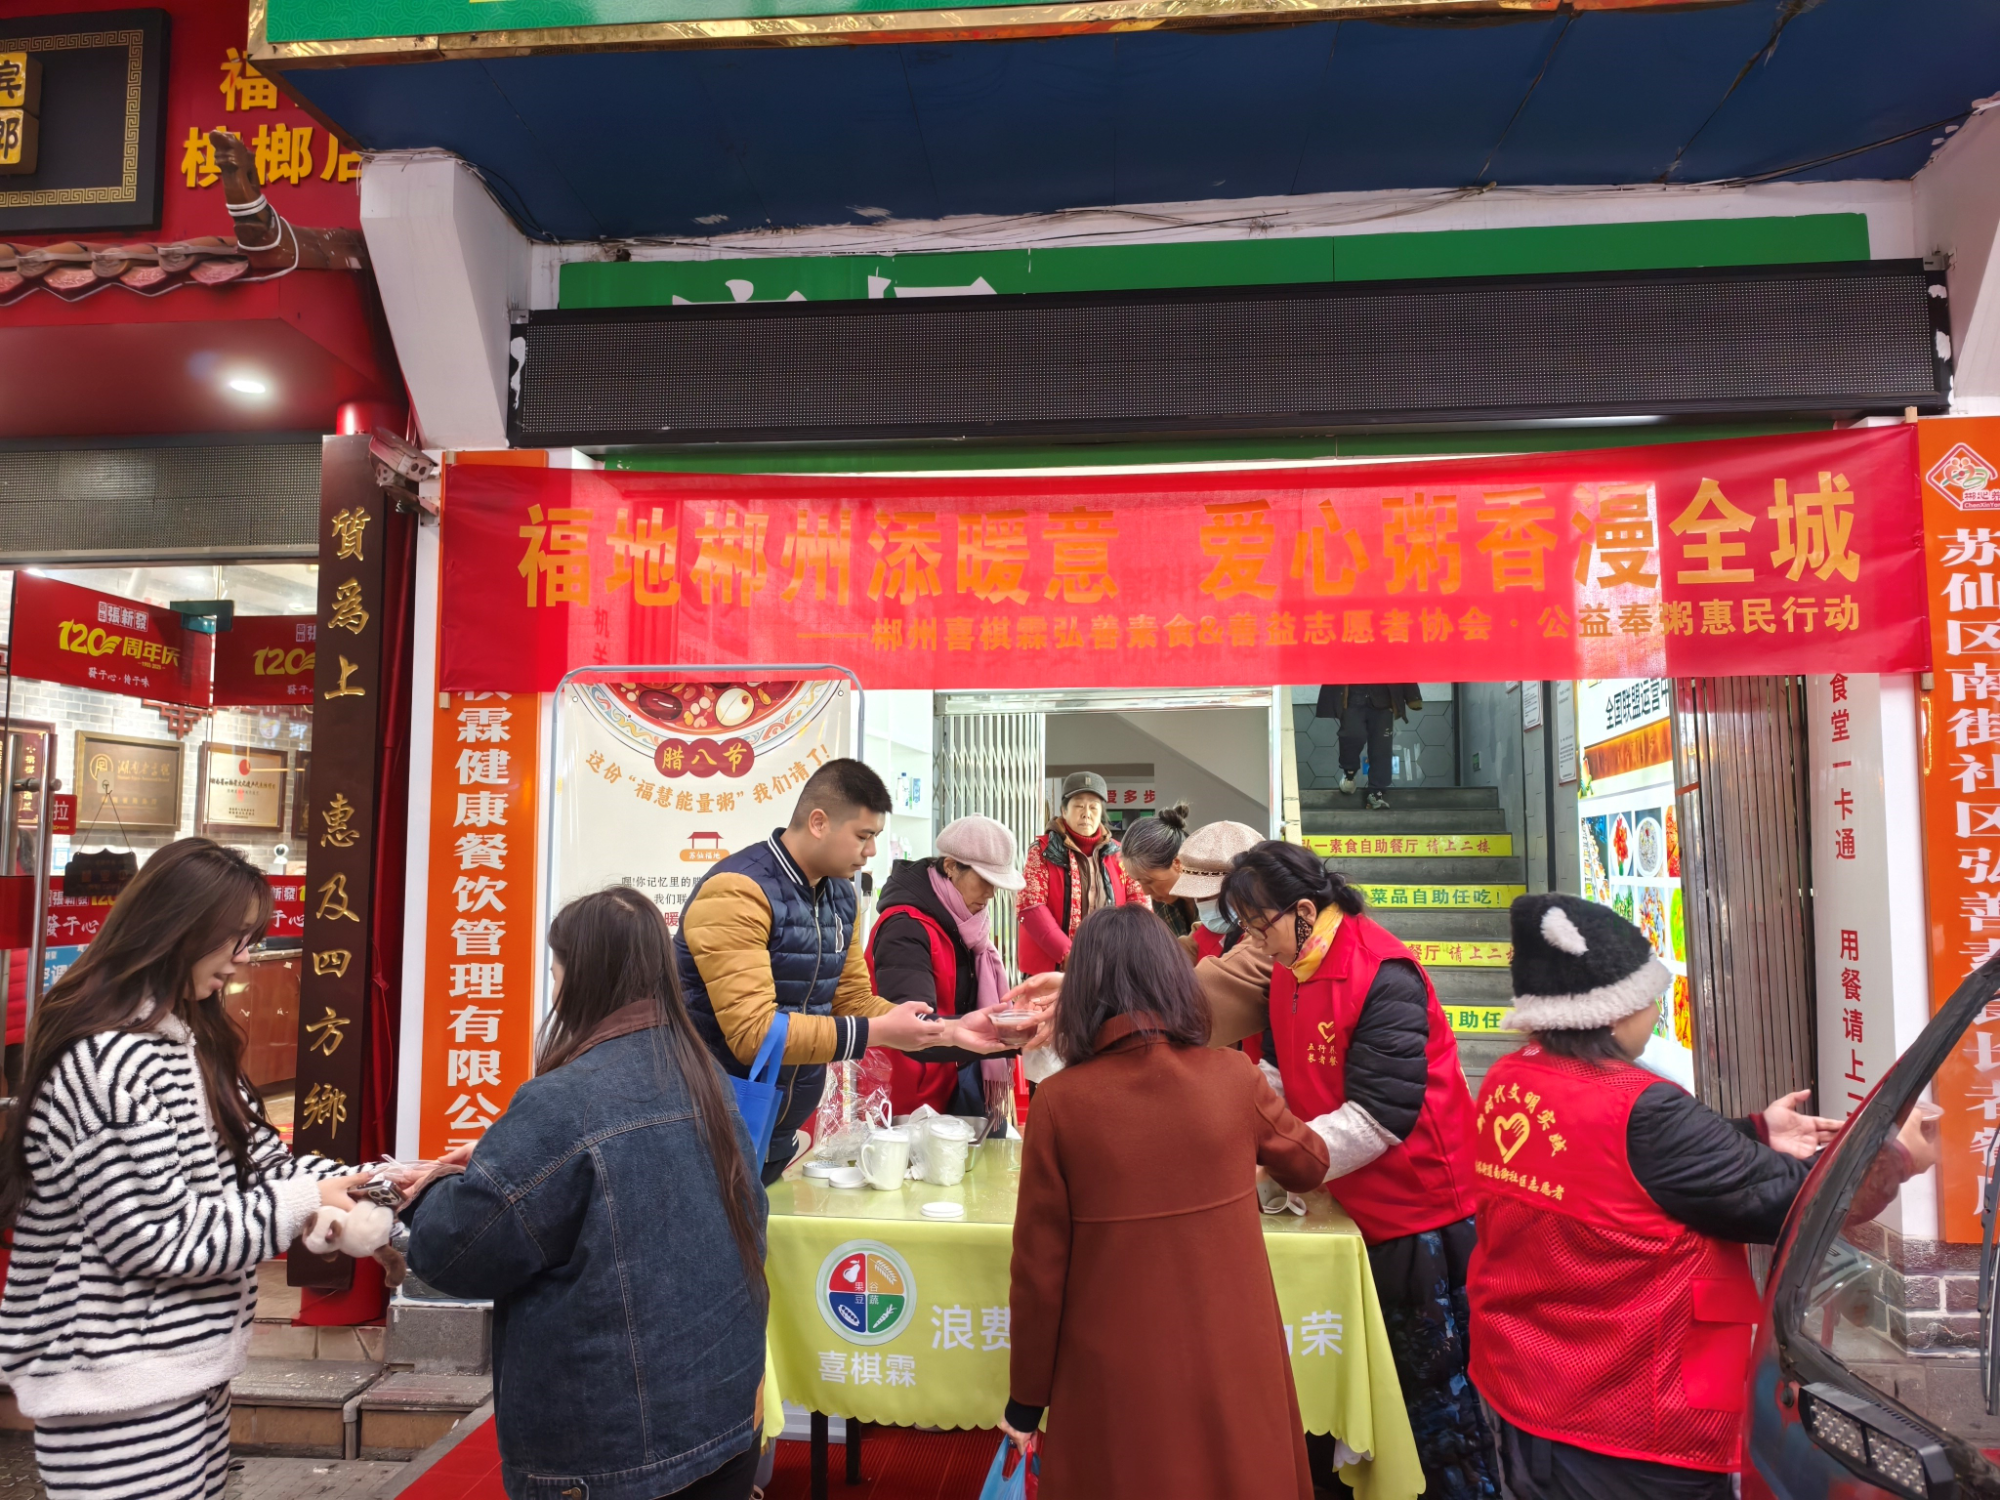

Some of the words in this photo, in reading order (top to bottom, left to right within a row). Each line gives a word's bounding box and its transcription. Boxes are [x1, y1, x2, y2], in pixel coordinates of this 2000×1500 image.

[219, 47, 280, 111] 福
[517, 503, 1119, 608] 福地郴州添暖意
[1199, 470, 1862, 602] 爱心粥香漫全城
[58, 618, 181, 668] 120周年庆
[252, 646, 316, 676] 120
[661, 741, 748, 774] 腊八节
[1829, 673, 1857, 860] 食堂一卡通
[52, 800, 69, 821] 拉
[1426, 838, 1491, 855] 请上二楼
[443, 692, 513, 1161] 霖健康餐饮管理有限公
[302, 792, 360, 1166] 惠及四方鄉
[854, 1294, 865, 1305] 豆
[869, 1281, 879, 1292] 谷
[930, 1303, 1012, 1352] 浪费
[817, 1349, 917, 1389] 喜棋霖
